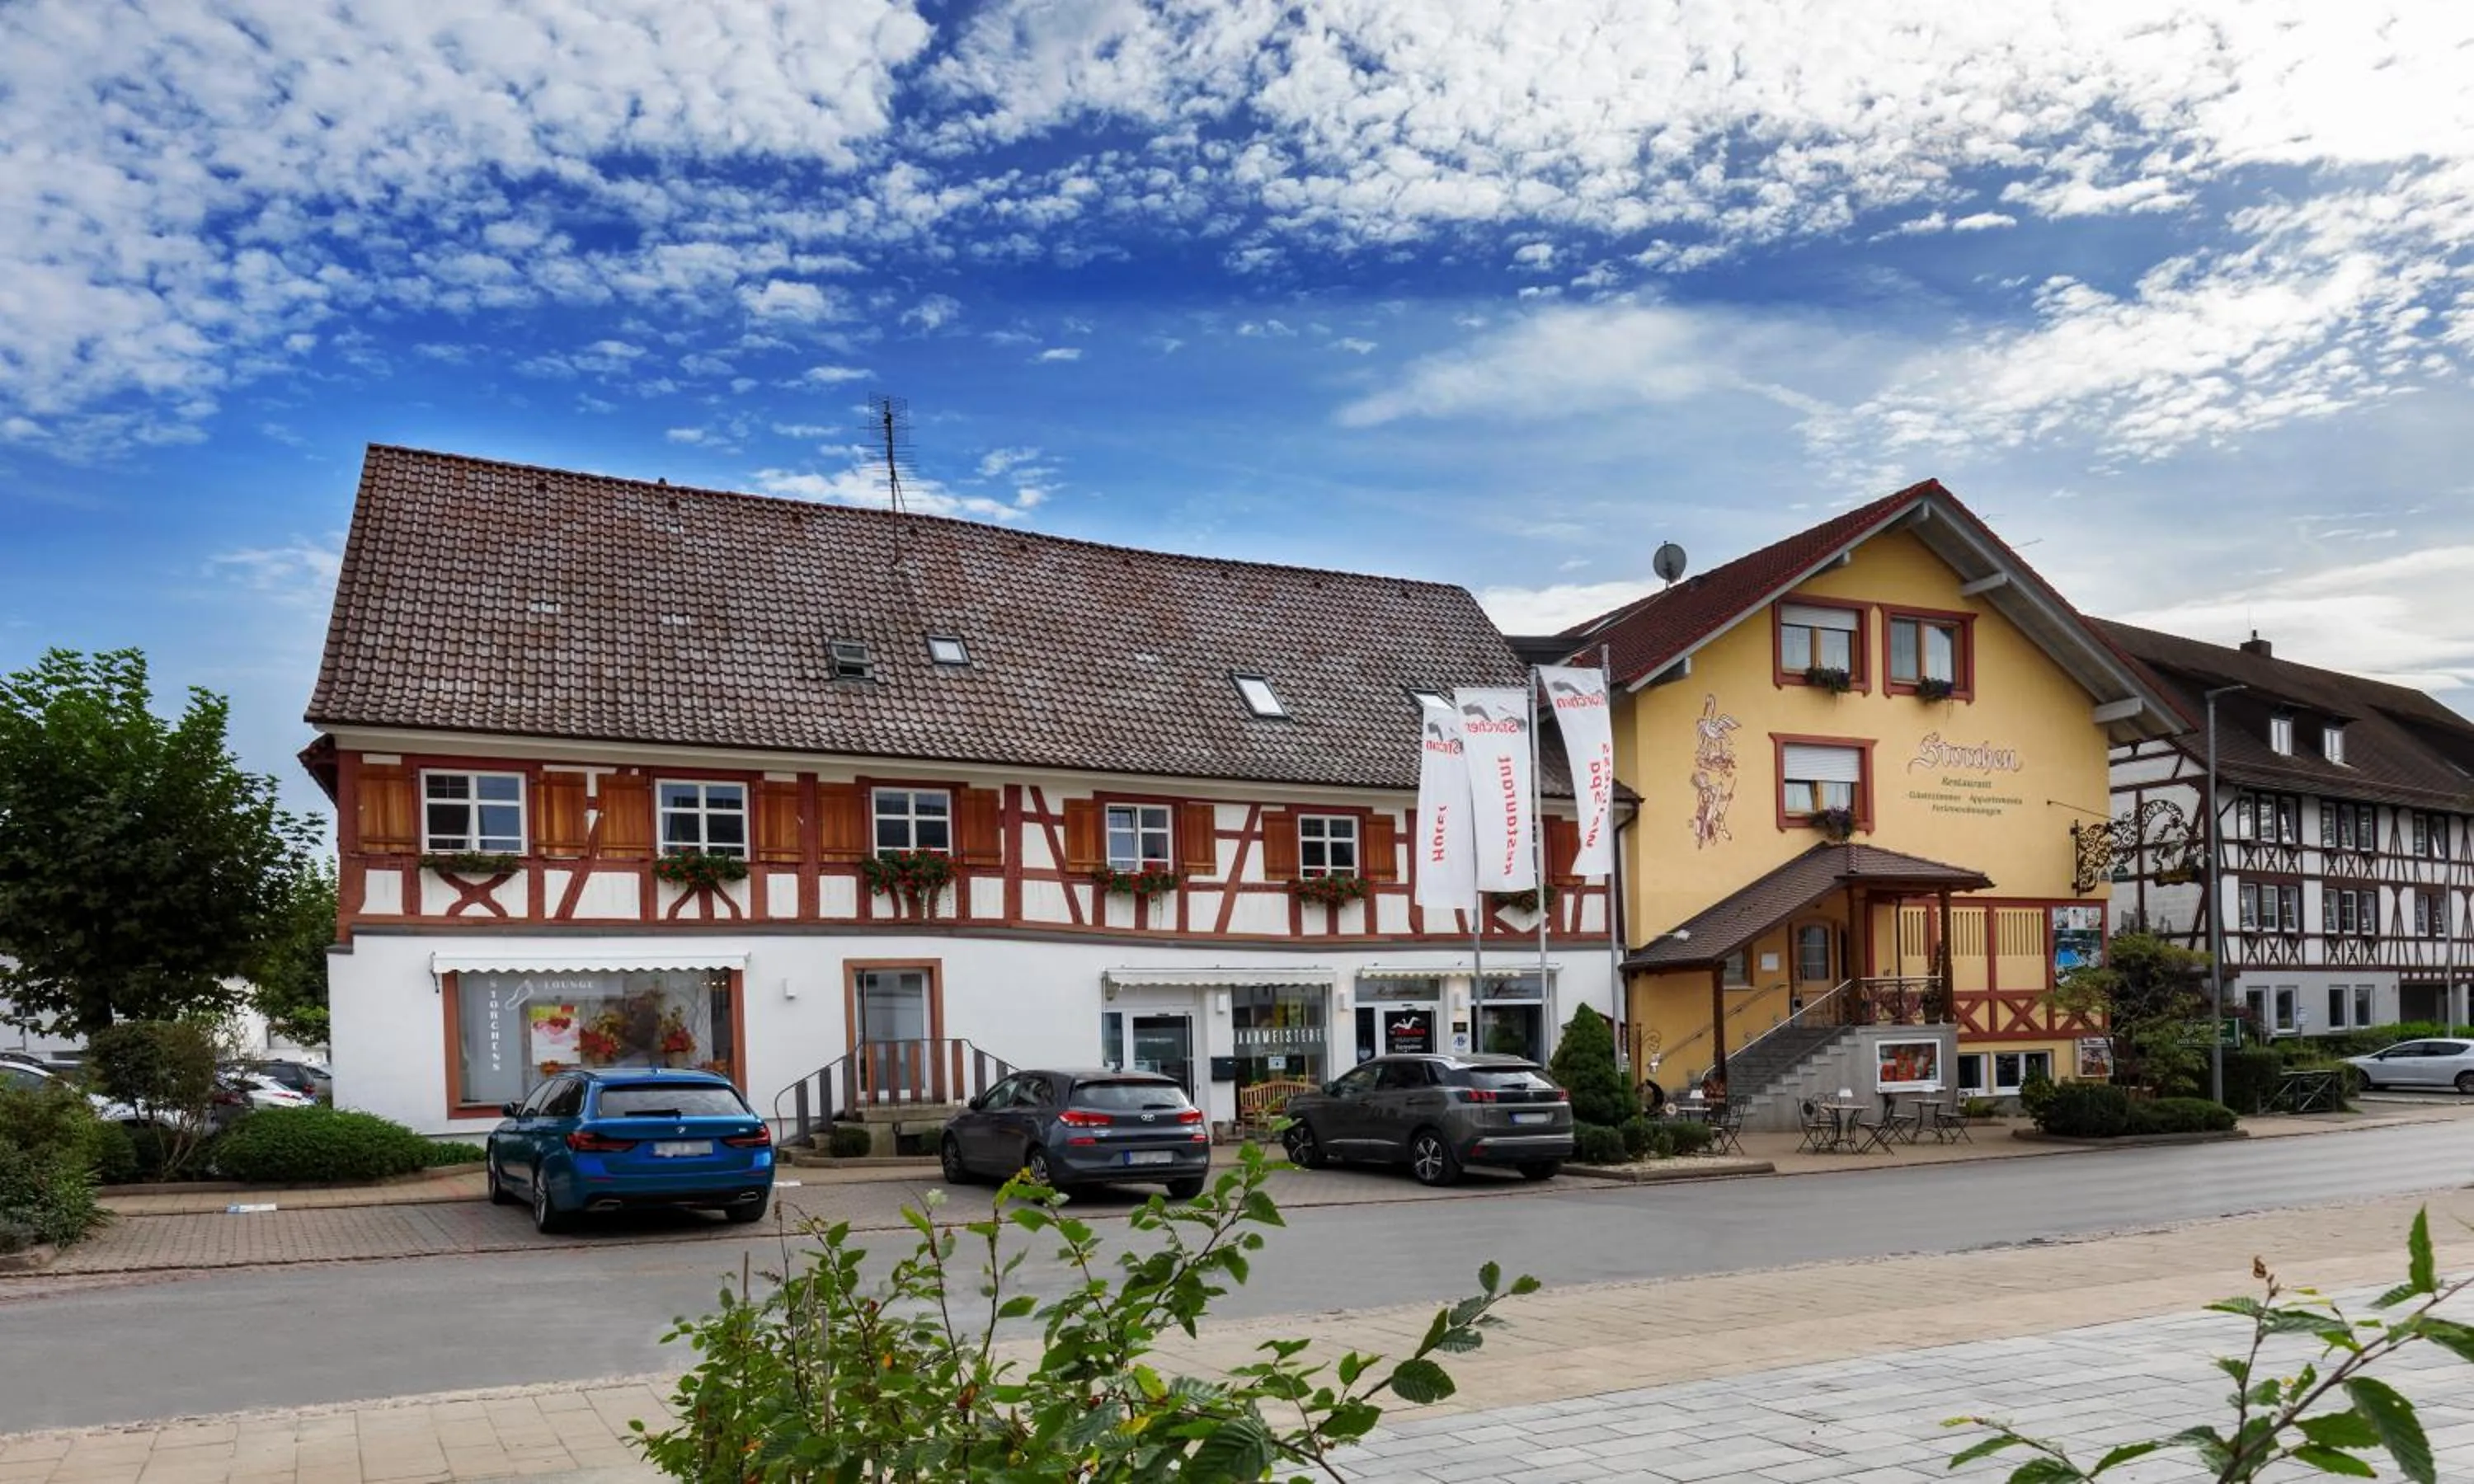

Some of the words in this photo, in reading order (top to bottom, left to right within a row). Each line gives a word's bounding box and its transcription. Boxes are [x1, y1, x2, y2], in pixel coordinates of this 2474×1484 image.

[1907, 732, 2023, 775] Storchen
[1940, 777, 1992, 789] Restaurant
[543, 980, 595, 989] LOUNGE
